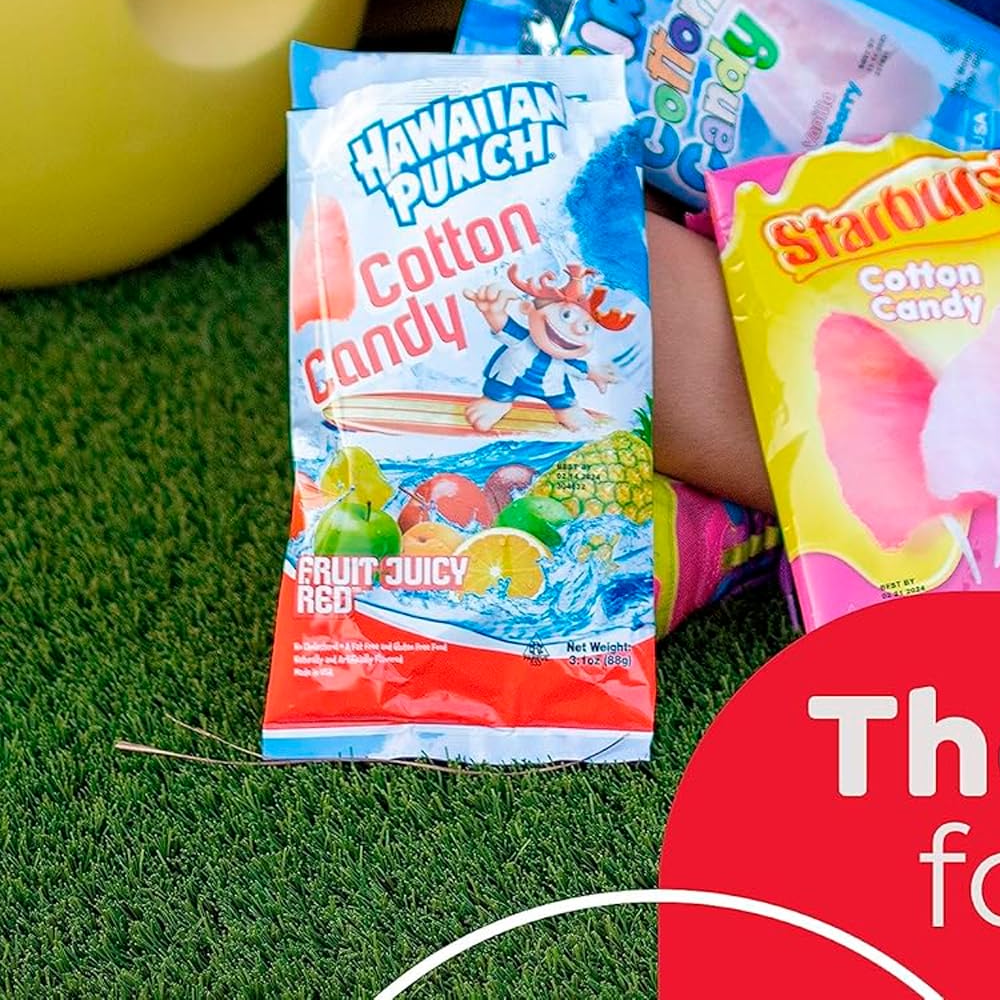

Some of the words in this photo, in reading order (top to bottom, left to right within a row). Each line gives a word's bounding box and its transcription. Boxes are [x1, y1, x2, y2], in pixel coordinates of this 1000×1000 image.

[677, 10, 780, 192] Candy
[347, 81, 568, 196] HAWAIIAN
[358, 202, 543, 309] Cotton
[859, 260, 983, 294] Cotton
[871, 291, 983, 324] Candy
[303, 293, 469, 406] Candy
[298, 556, 378, 586] FRUIT
[385, 556, 469, 586] JUICY
[880, 580, 902, 592] BEST
[903, 578, 915, 586] BY
[297, 585, 353, 614] RED
[566, 641, 587, 653] Net
[590, 641, 632, 654] Weight:
[603, 654, 632, 667] (88g)
